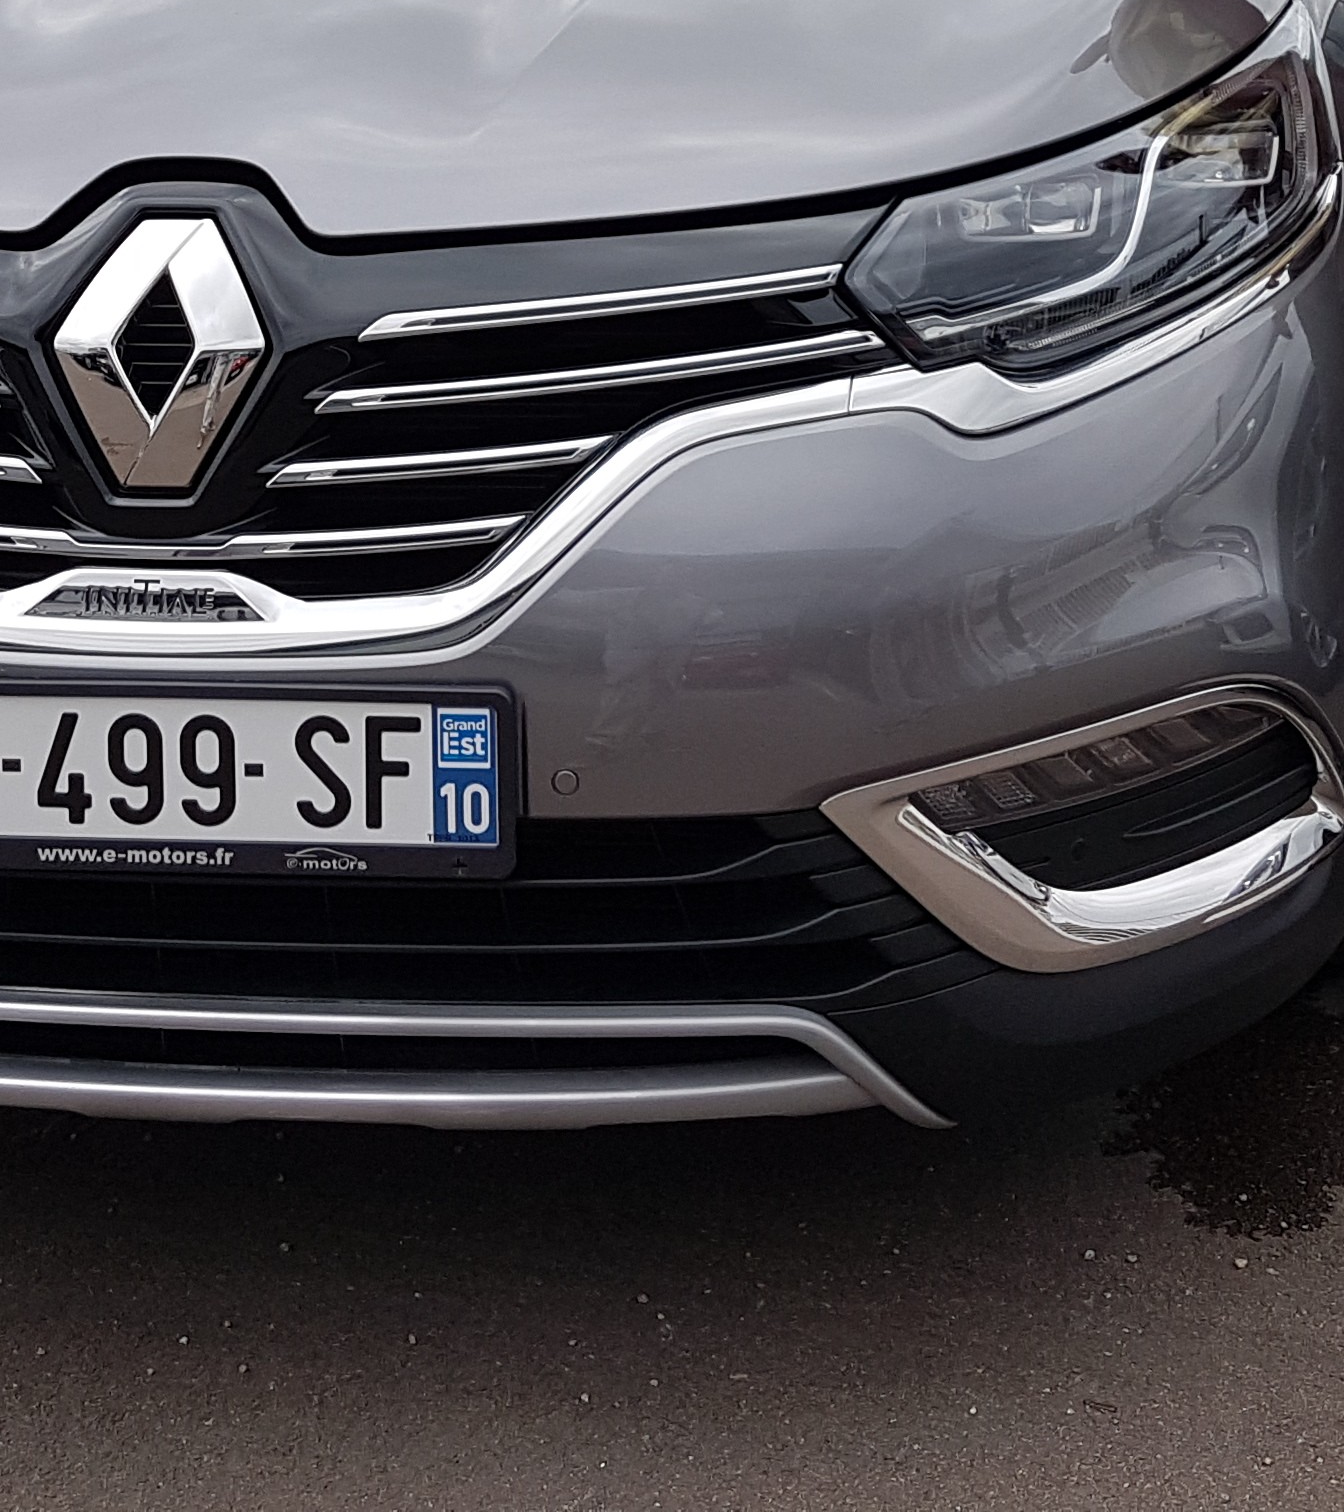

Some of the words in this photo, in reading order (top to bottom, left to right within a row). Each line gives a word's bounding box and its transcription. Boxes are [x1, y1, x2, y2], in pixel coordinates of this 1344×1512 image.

[442, 718, 486, 731] Grand
[442, 732, 486, 755] Est
[440, 782, 490, 834] 10
[37, 847, 234, 865] www.e-motors.fr
